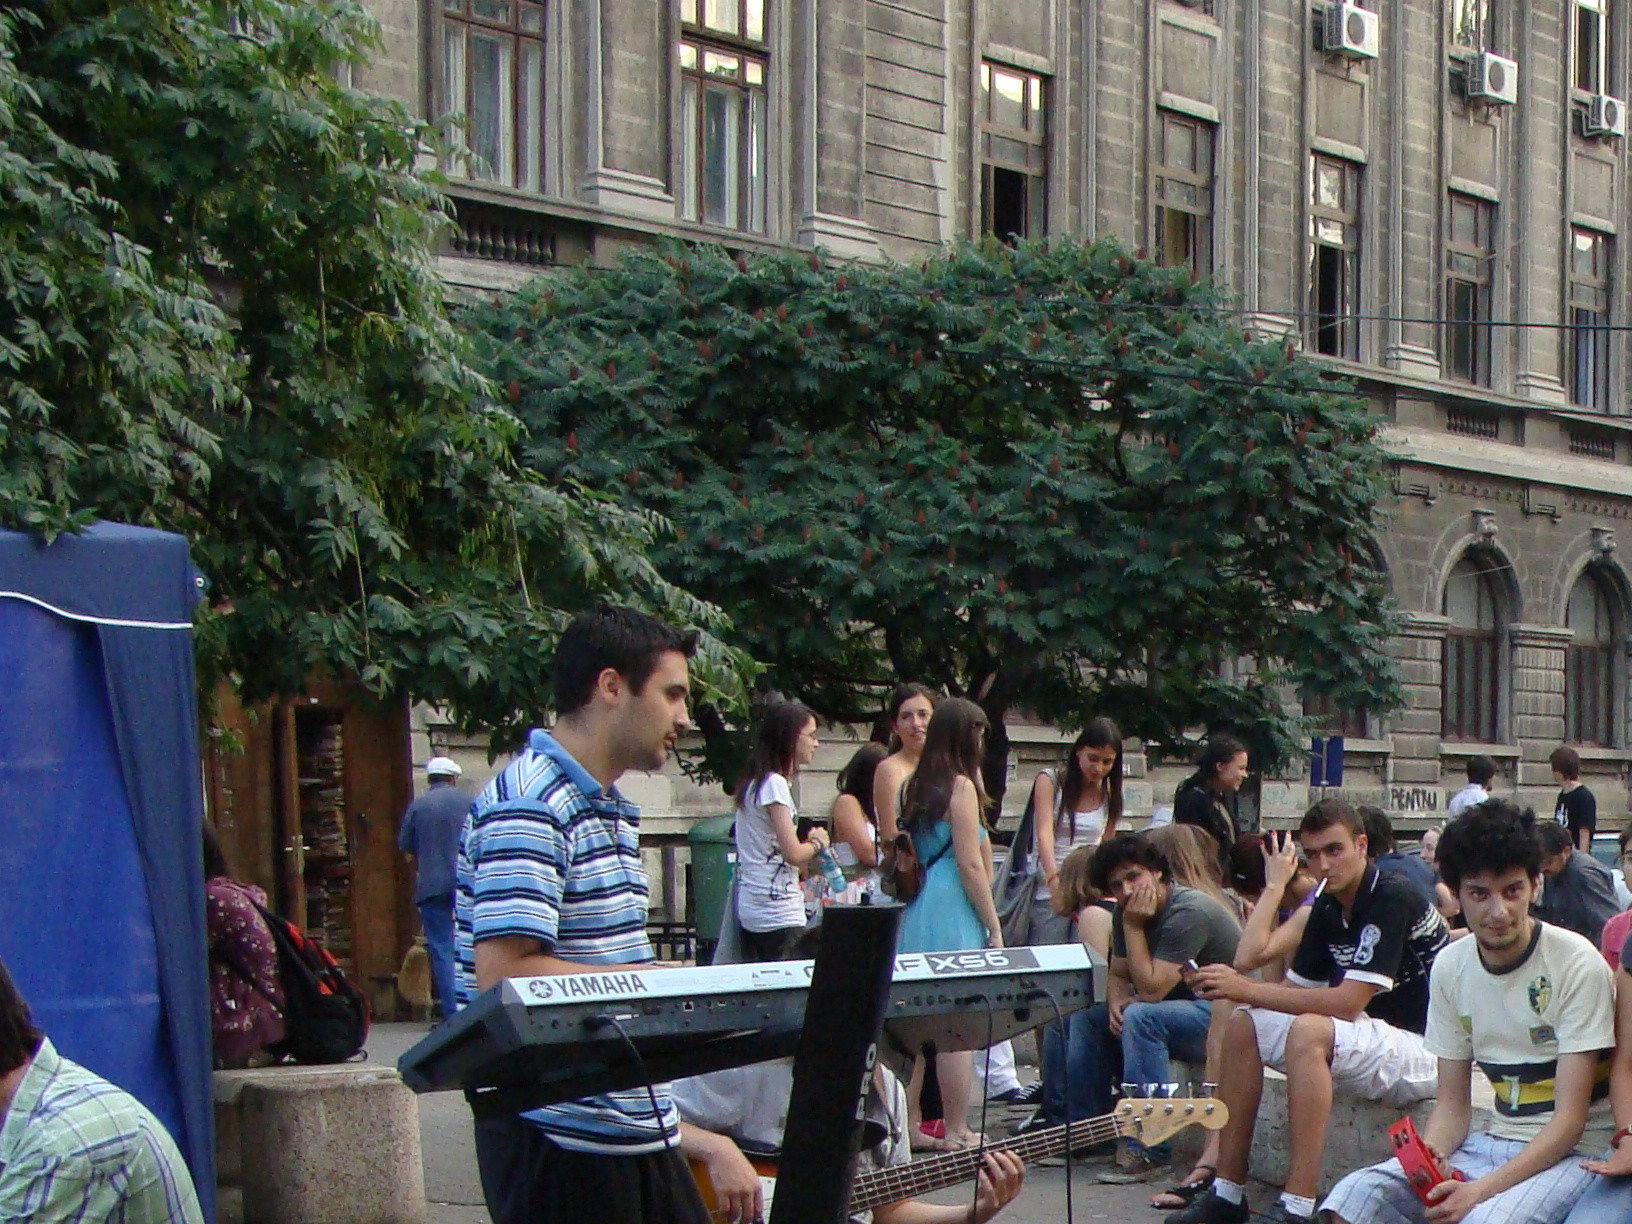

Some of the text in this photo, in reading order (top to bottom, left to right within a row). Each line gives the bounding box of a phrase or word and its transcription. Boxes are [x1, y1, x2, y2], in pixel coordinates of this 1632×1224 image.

[1391, 788, 1437, 811] PENTRU
[930, 951, 1009, 970] XS6
[553, 974, 648, 997] YAMAHA
